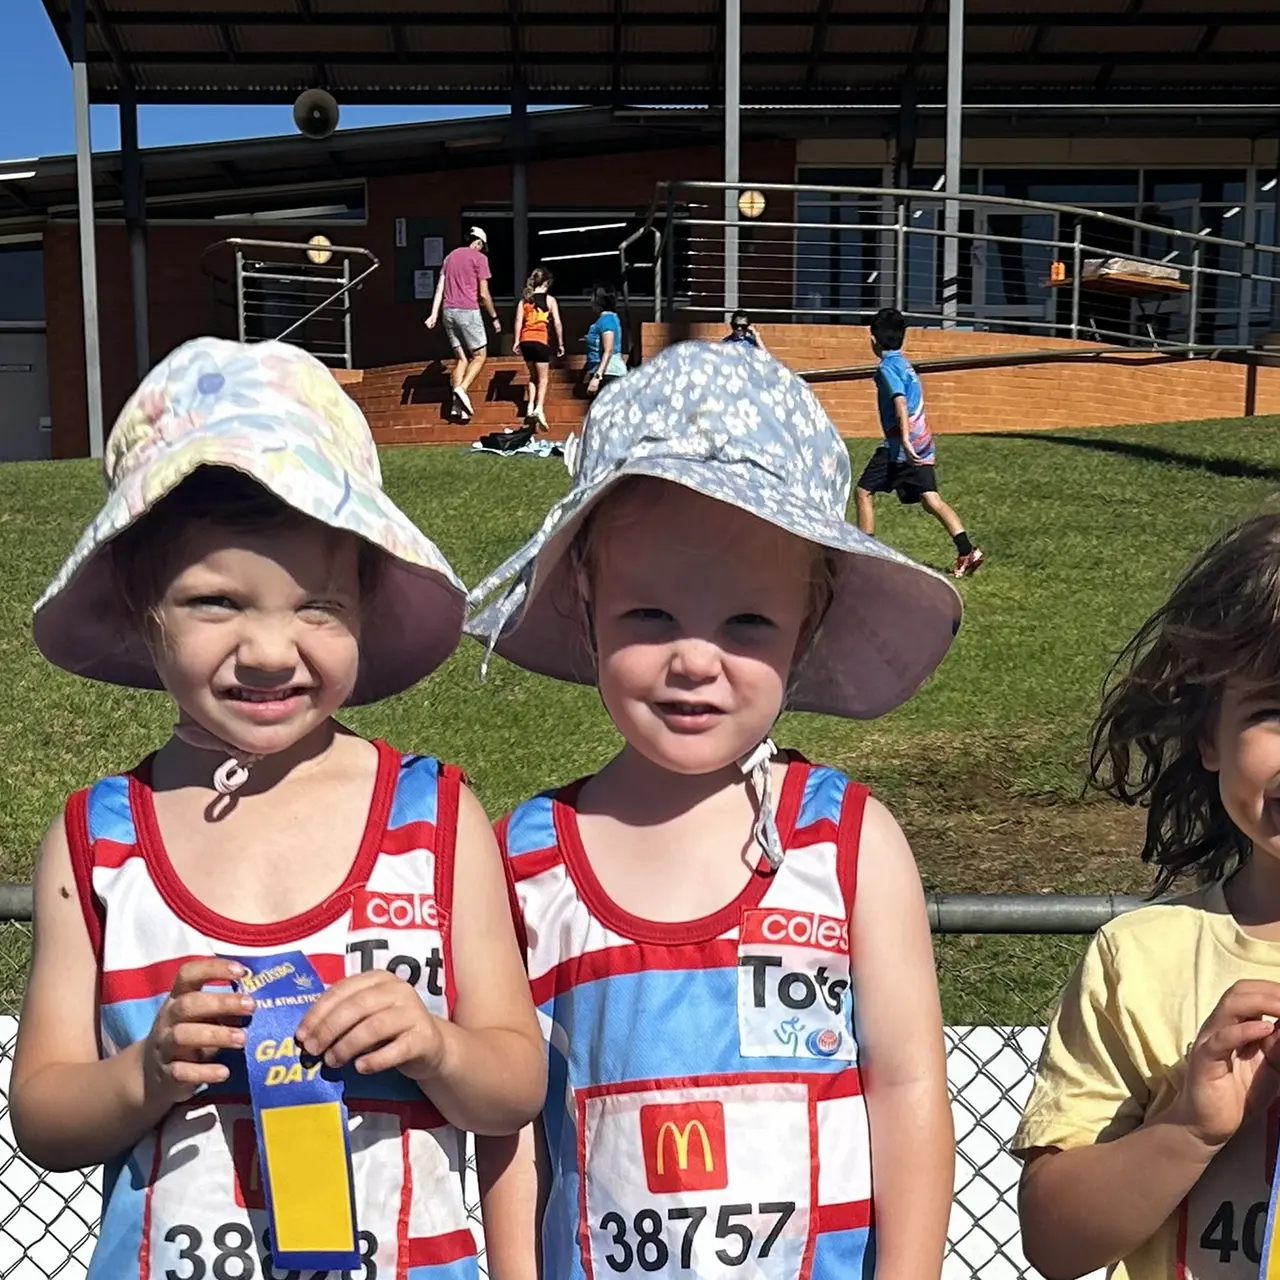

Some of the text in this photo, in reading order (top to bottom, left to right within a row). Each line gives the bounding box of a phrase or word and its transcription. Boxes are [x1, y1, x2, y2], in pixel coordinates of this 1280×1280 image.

[366, 893, 438, 926] cole
[762, 912, 848, 951] coles
[346, 939, 443, 996] Tot
[275, 992, 322, 1006] ATHLETIC
[255, 1037, 301, 1061] GA
[264, 1062, 322, 1086] DAY
[599, 1201, 796, 1273] 38757
